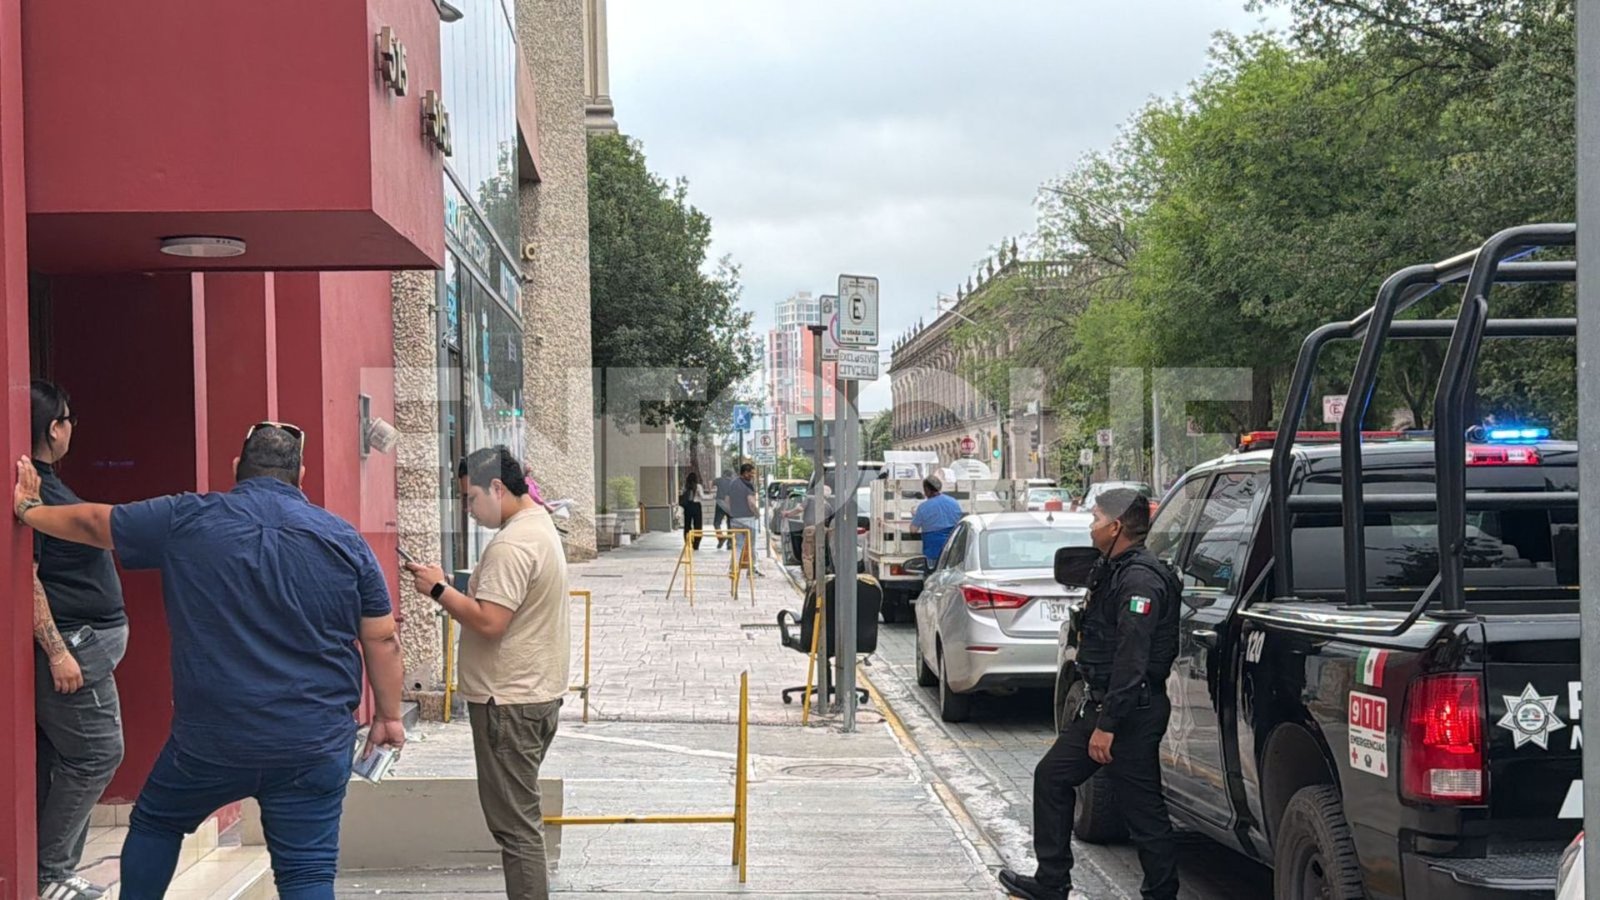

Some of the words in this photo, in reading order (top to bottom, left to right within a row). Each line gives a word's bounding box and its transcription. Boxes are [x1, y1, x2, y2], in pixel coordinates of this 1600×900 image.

[853, 298, 861, 320] E
[1246, 630, 1265, 663] 120
[1352, 700, 1383, 728] 911
[1350, 735, 1385, 752] EMERGENCIAS
